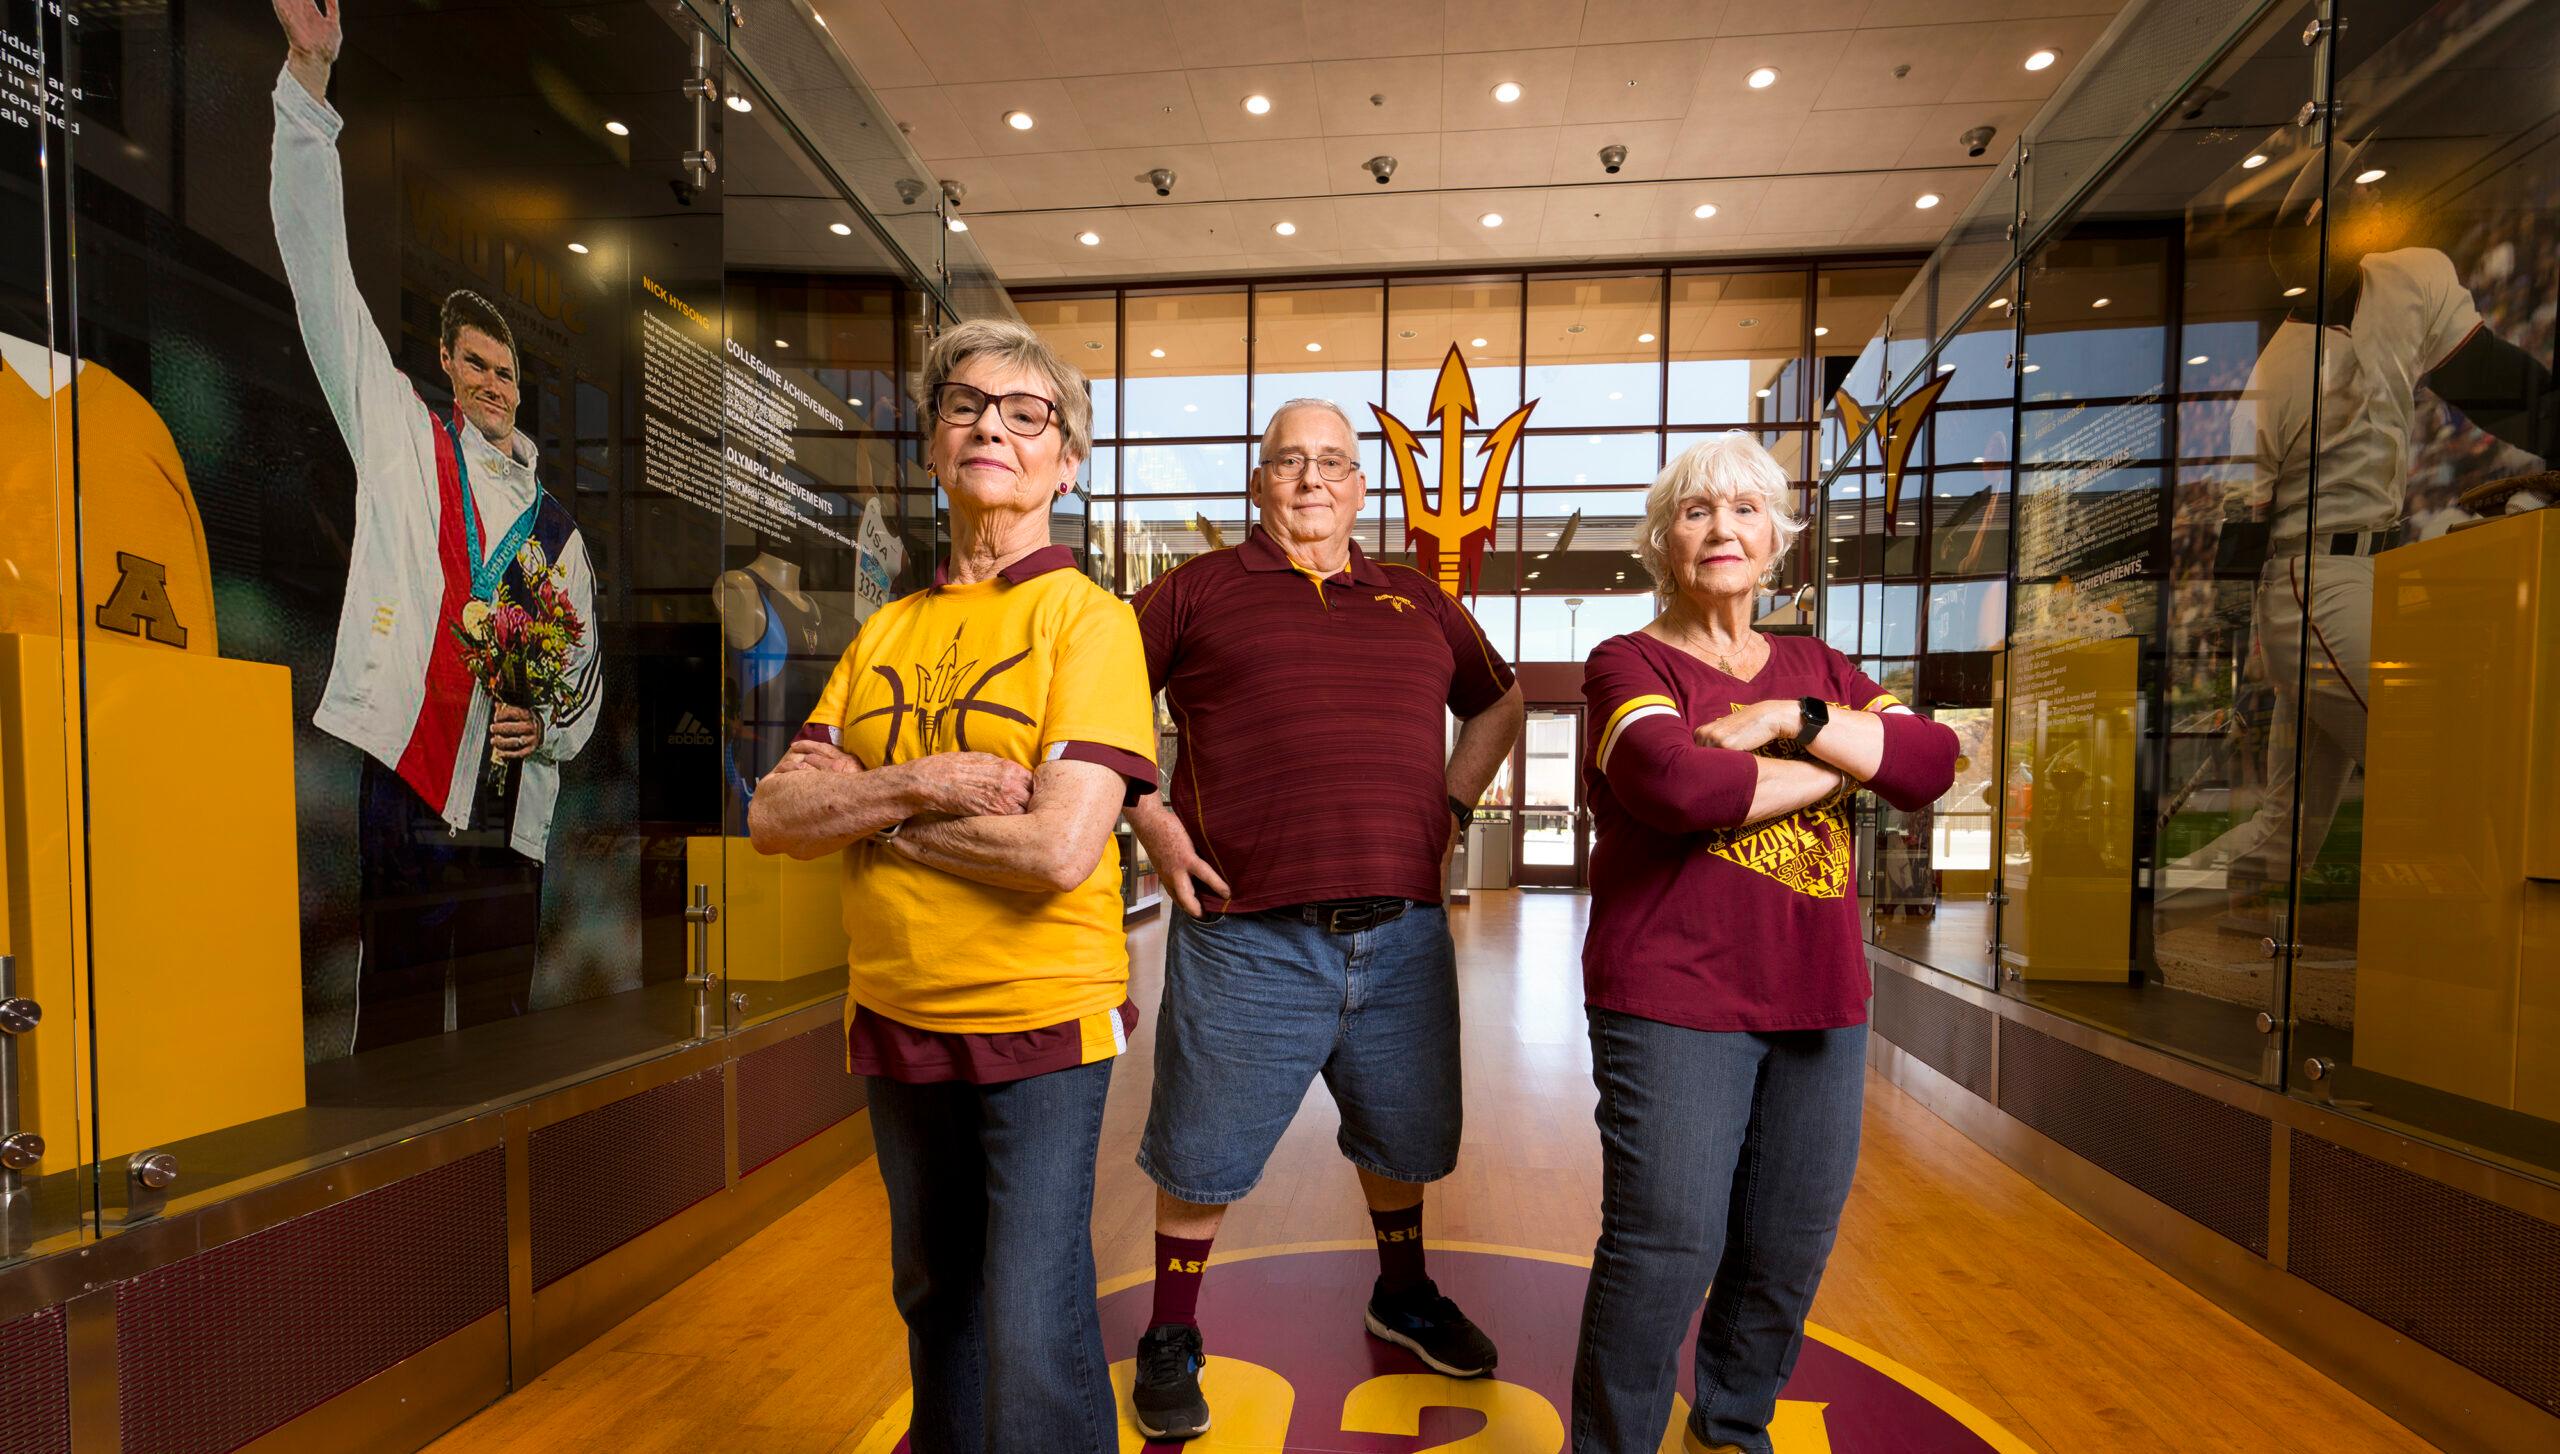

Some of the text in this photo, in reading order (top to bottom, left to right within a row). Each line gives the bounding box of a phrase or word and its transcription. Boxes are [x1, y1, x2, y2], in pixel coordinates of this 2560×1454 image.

[0, 48, 41, 79] imes
[8, 71, 24, 90] in
[643, 276, 710, 330] NICK HYSONG
[645, 371, 660, 386] NCAA
[726, 337, 782, 389] COLLEGIATE
[783, 379, 845, 432] ACHIEVEMENTS
[645, 413, 671, 434] Following
[646, 455, 668, 471] Summer
[726, 446, 769, 480] OLYMPIC
[770, 471, 834, 515] ACHIEVEMENTS
[797, 512, 818, 528] Summer
[817, 522, 837, 539] Olympic
[836, 531, 851, 546] Games
[866, 520, 889, 561] USA
[96, 551, 188, 649] A
[860, 571, 883, 609] 3326
[2018, 587, 2073, 616] PROESIONAL
[2074, 558, 2142, 596] ACHIEVEMENTS
[1749, 830, 1823, 876] STAE
[1777, 841, 1831, 883] SUN
[1377, 1225, 1419, 1243] ASU
